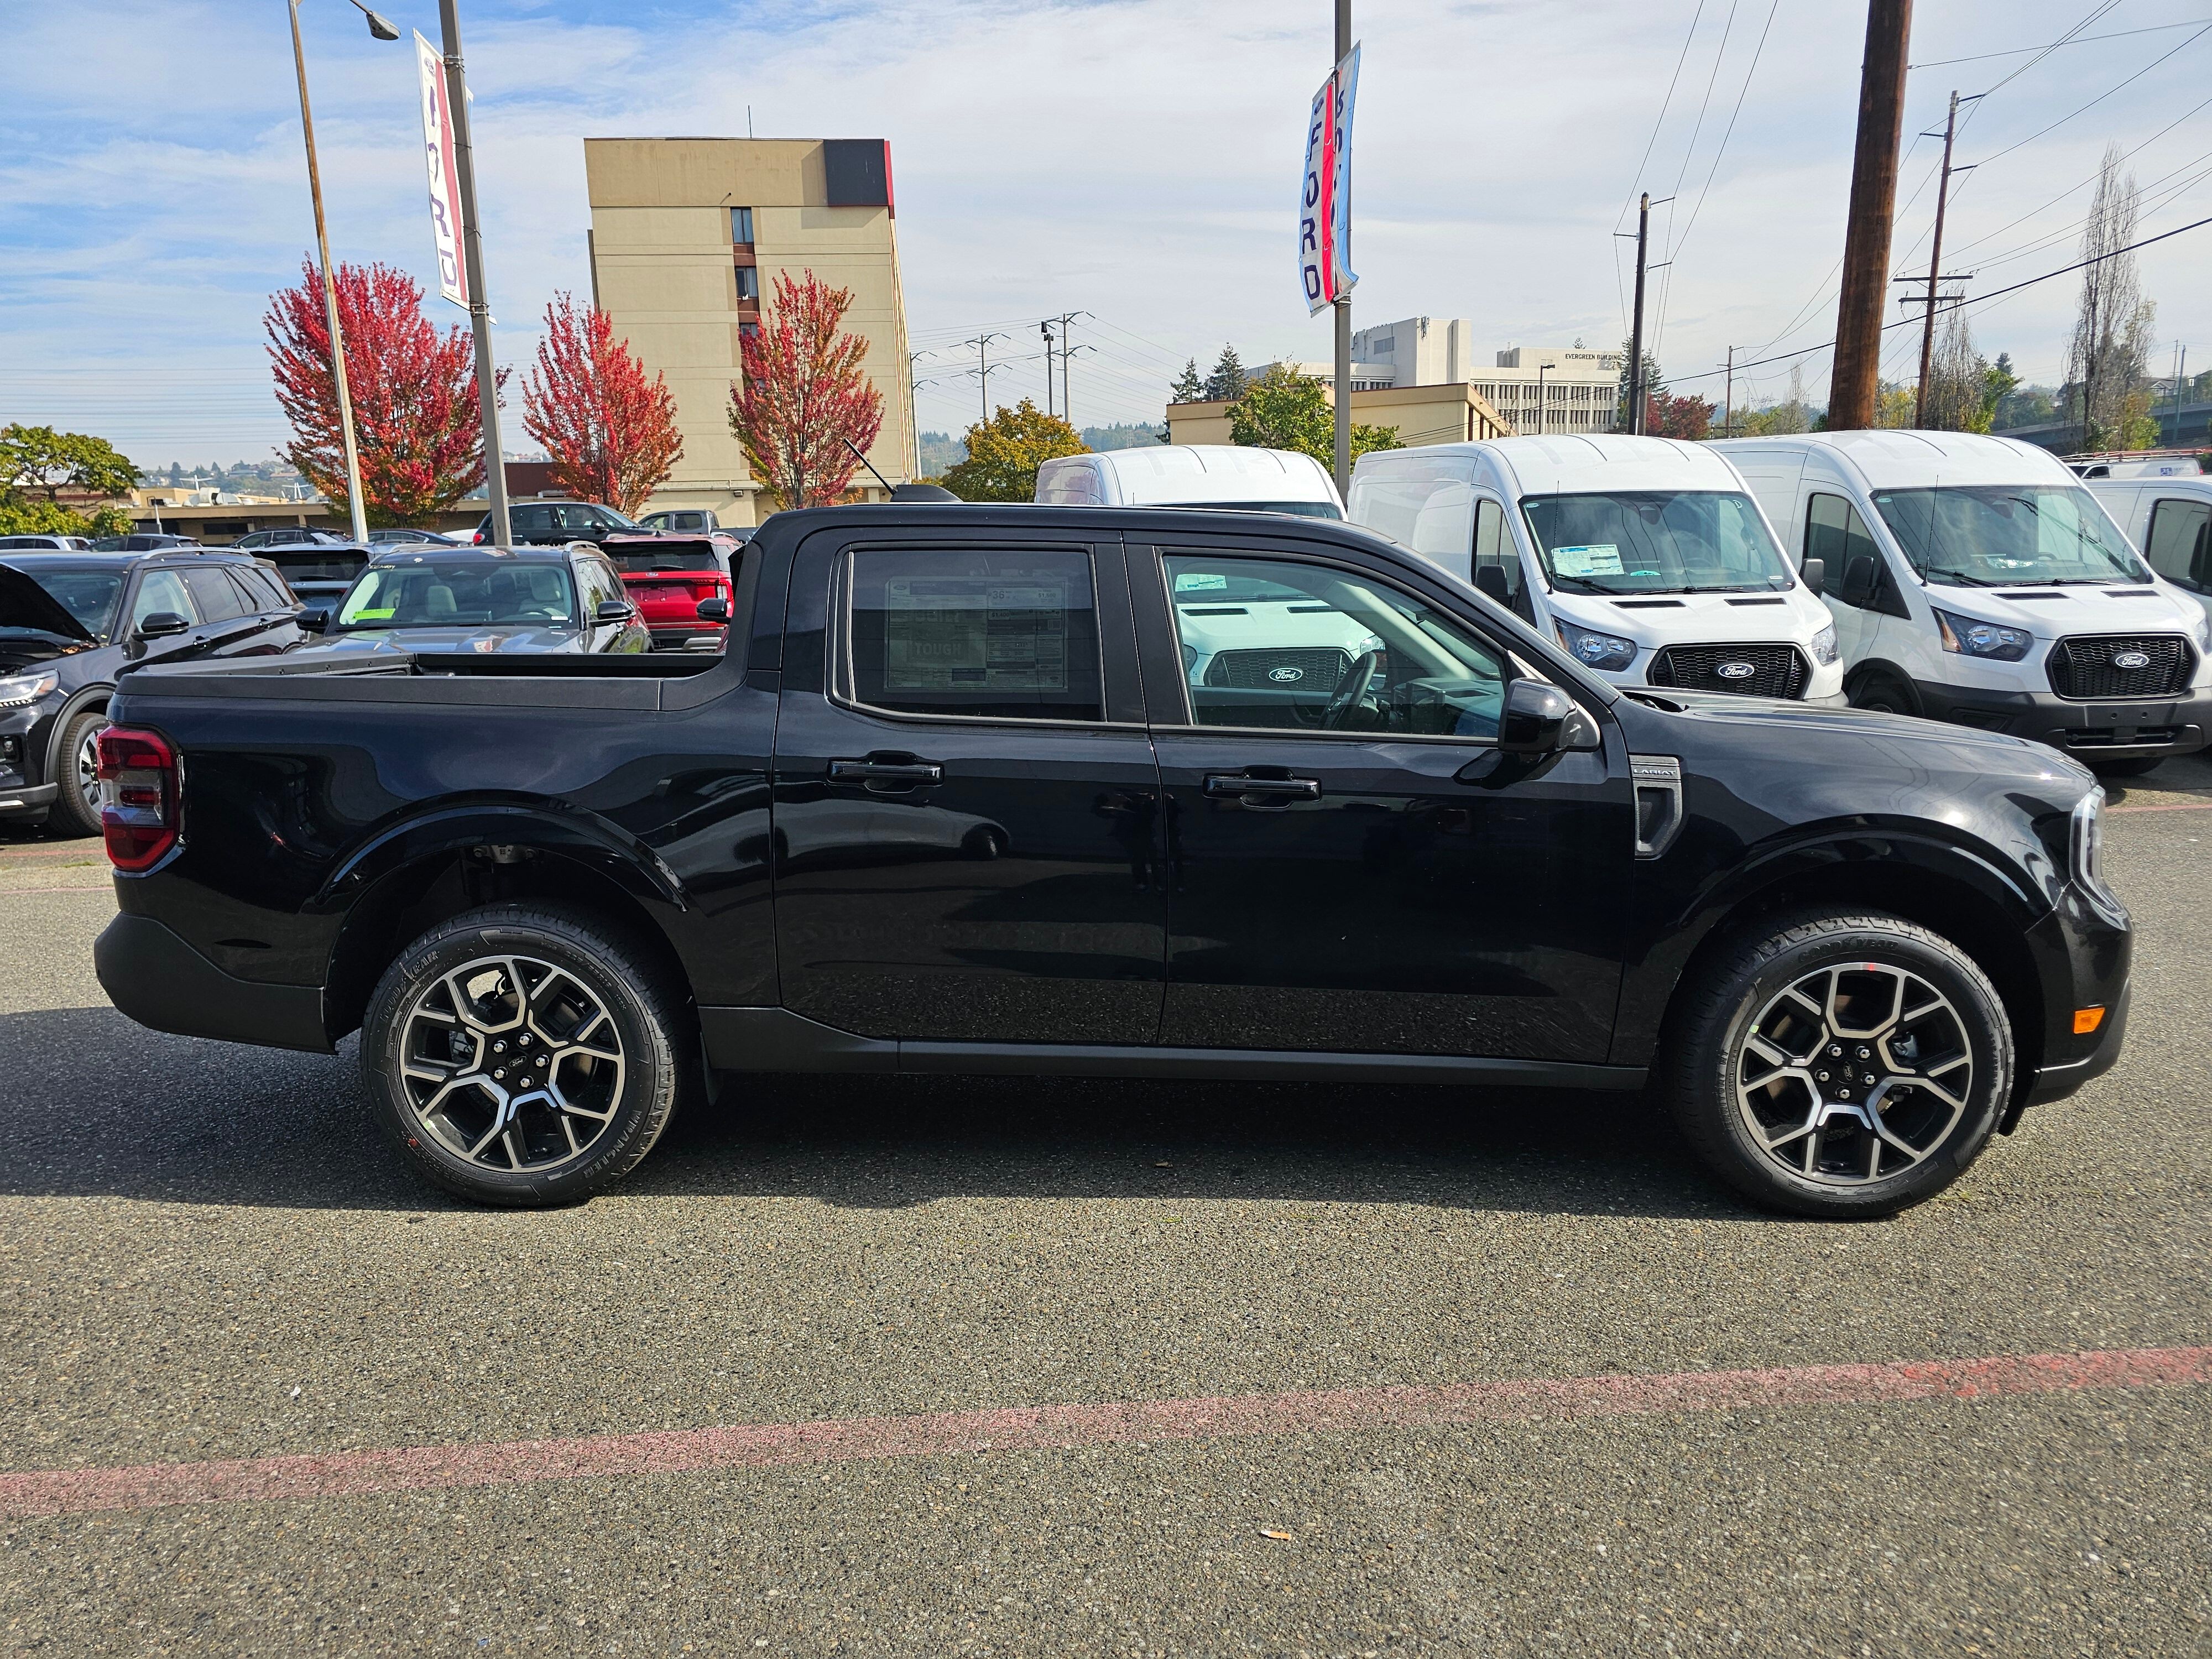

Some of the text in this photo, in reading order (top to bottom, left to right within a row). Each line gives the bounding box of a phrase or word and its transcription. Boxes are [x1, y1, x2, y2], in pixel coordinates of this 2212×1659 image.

[1302, 121, 1322, 300] FORD
[993, 590, 1005, 599] 36
[915, 642, 962, 655] TOUGH
[2122, 656, 2143, 665] Ford
[1275, 670, 1296, 680] Ford
[1725, 665, 1747, 675] Ford
[512, 1057, 523, 1067] Ford
[583, 1110, 642, 1178] WRANGLER
